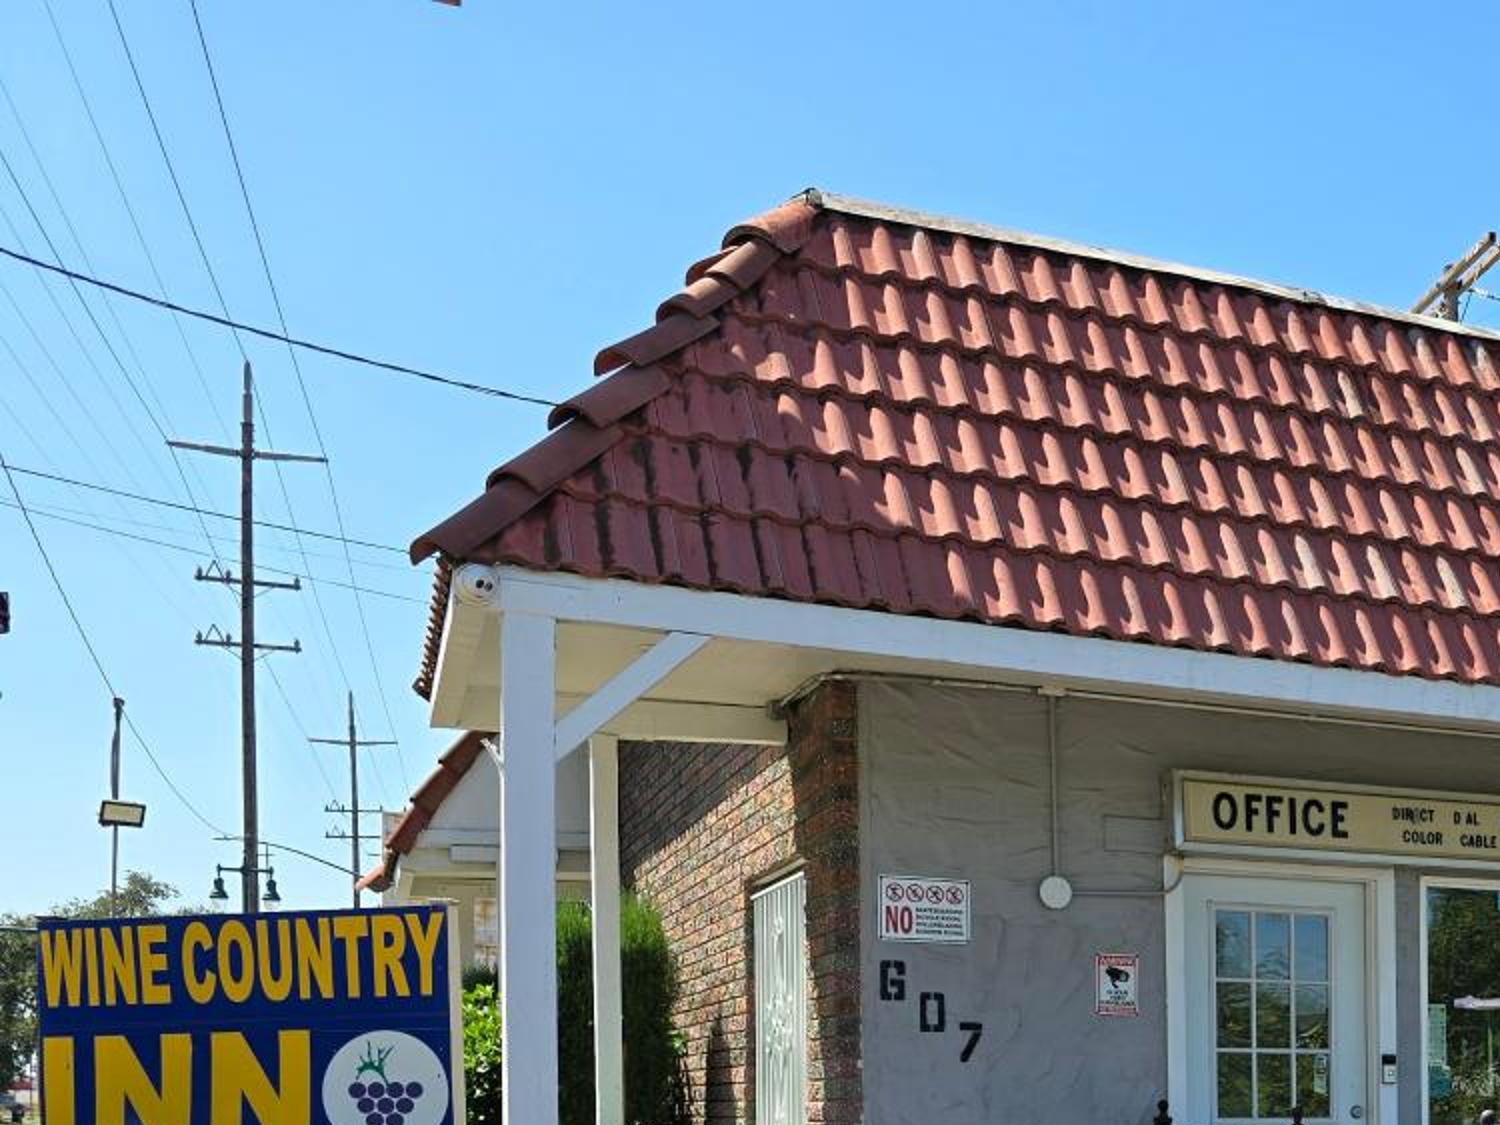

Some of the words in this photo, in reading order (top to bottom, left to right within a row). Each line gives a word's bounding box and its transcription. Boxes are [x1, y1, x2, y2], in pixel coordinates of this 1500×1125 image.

[1212, 791, 1350, 839] OFFICE
[1402, 830, 1443, 846] COLOR
[1459, 834, 1497, 849] CABLE
[885, 905, 913, 935] NO
[40, 923, 172, 1008] WINE
[181, 911, 445, 1005] COUNTRY
